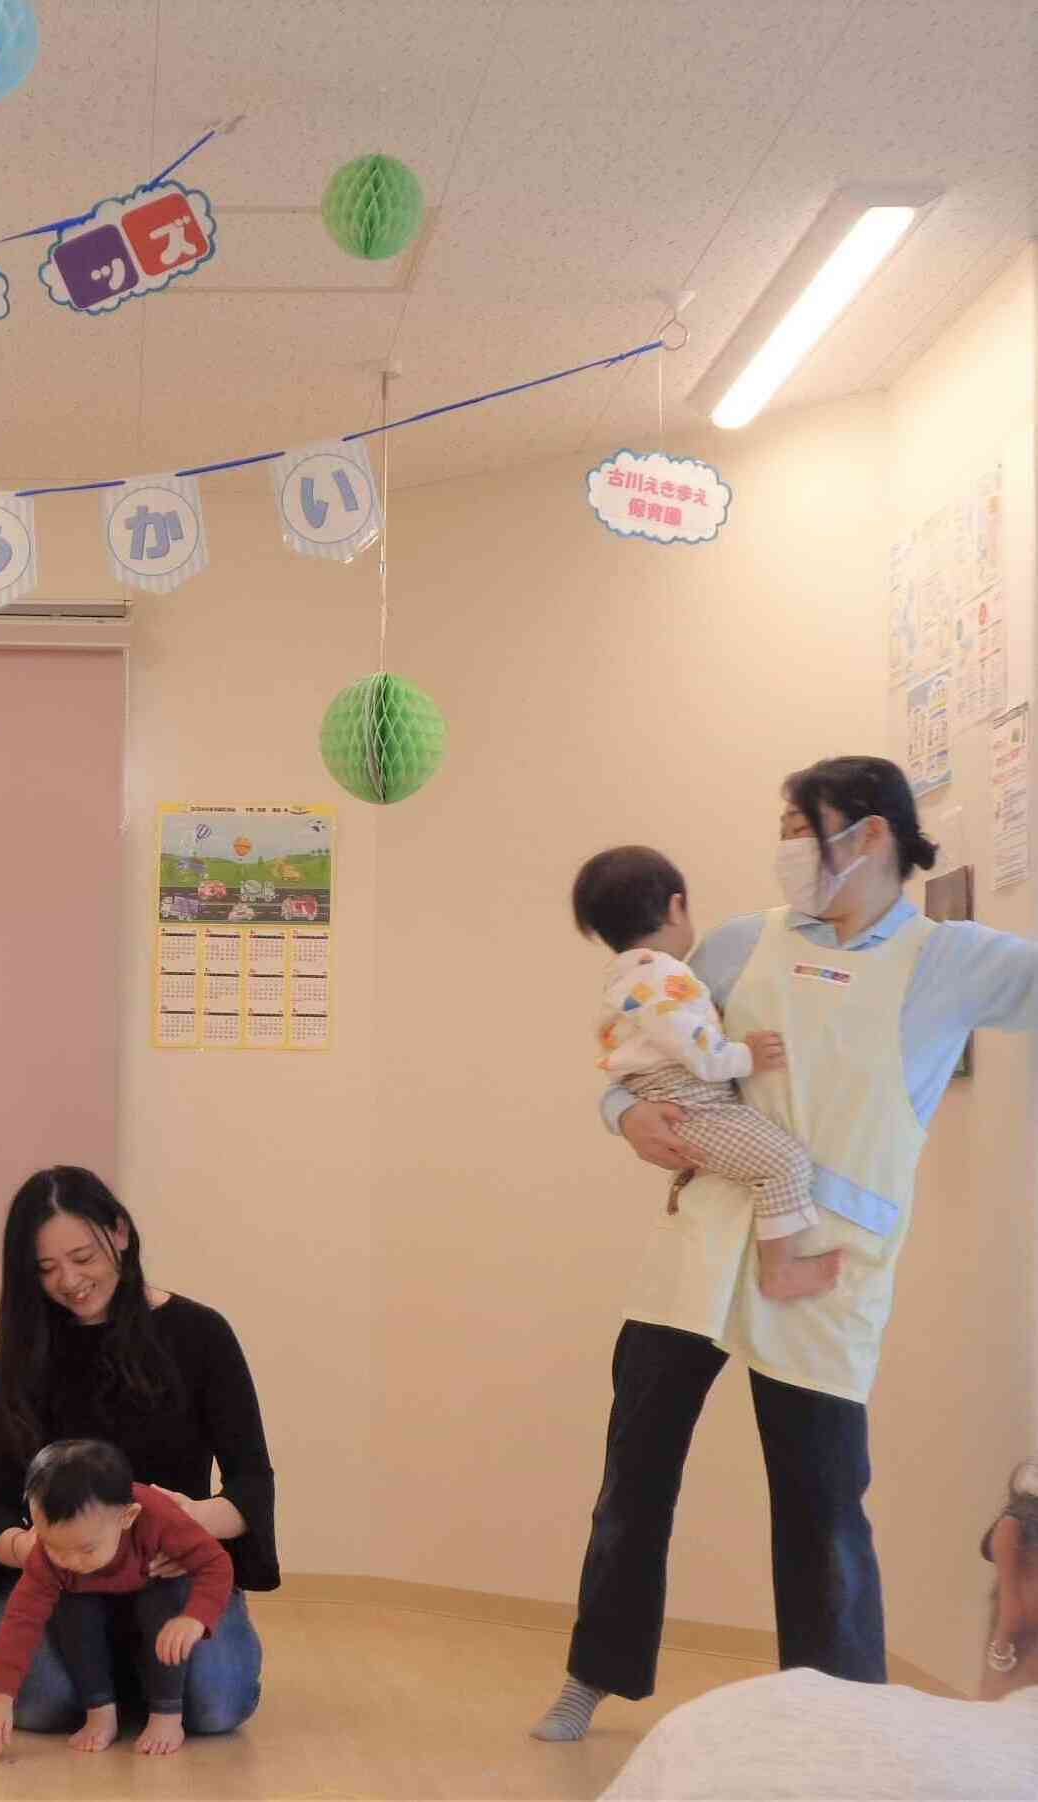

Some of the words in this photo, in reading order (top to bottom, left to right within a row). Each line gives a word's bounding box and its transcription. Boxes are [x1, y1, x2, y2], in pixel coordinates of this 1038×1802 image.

[606, 468, 708, 506] 古川えきまえ
[627, 498, 683, 526] 保育園
